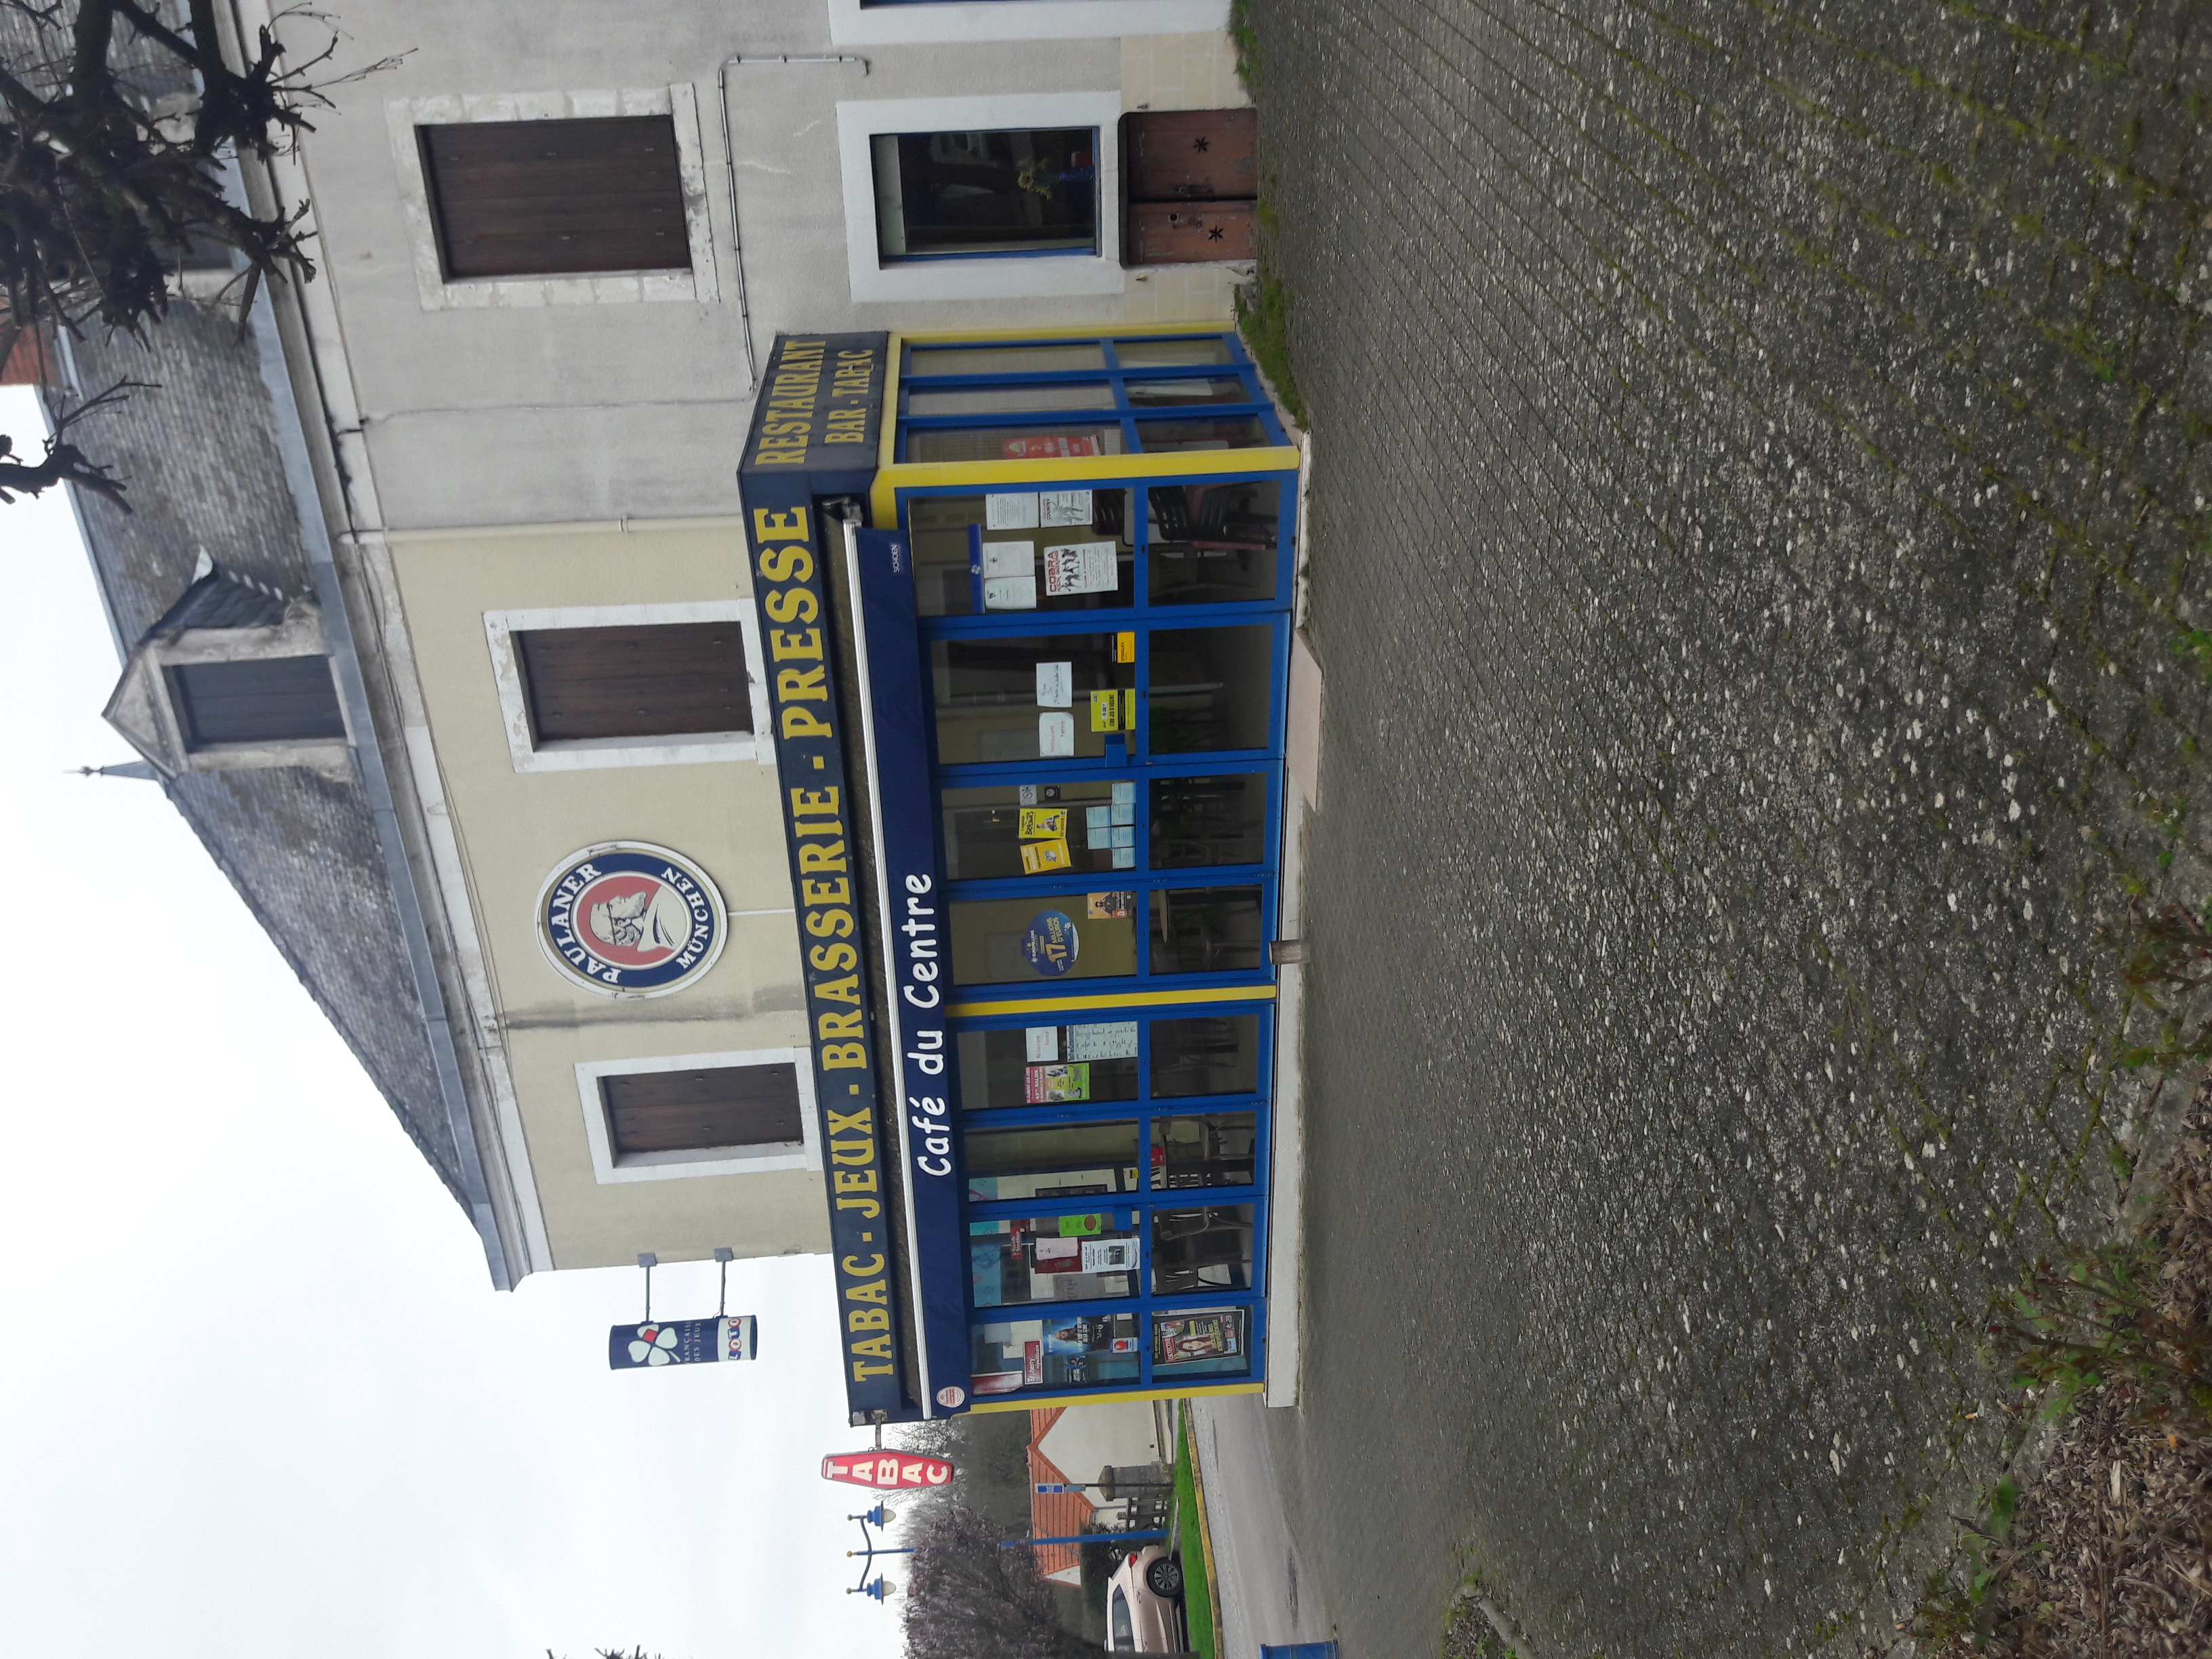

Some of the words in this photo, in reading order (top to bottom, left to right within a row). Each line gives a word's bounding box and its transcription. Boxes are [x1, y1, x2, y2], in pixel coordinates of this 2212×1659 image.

[832, 349, 874, 397] TABAC
[754, 340, 826, 465] RESTAURANT
[824, 407, 867, 444] BAR
[891, 544, 900, 573] SCHOEN
[1048, 552, 1057, 592] COBRA
[753, 506, 833, 739] PRESSE
[550, 863, 621, 983] PAULANER
[661, 867, 709, 969] MÜNCHEN
[790, 786, 868, 1071] BRASSERIE
[1046, 918, 1058, 943] MILLIONS
[1052, 917, 1064, 943] D'EUROS
[901, 874, 939, 1009] Centre
[1045, 943, 1067, 962] 17
[907, 1031, 943, 1075] du
[909, 1097, 951, 1176] Café
[827, 1107, 880, 1218] JEUX
[727, 1318, 742, 1360] LOTO
[842, 1253, 894, 1382] TABAC
[1165, 1337, 1174, 1359] DETECTIVE
[827, 1458, 947, 1486] TABAC
